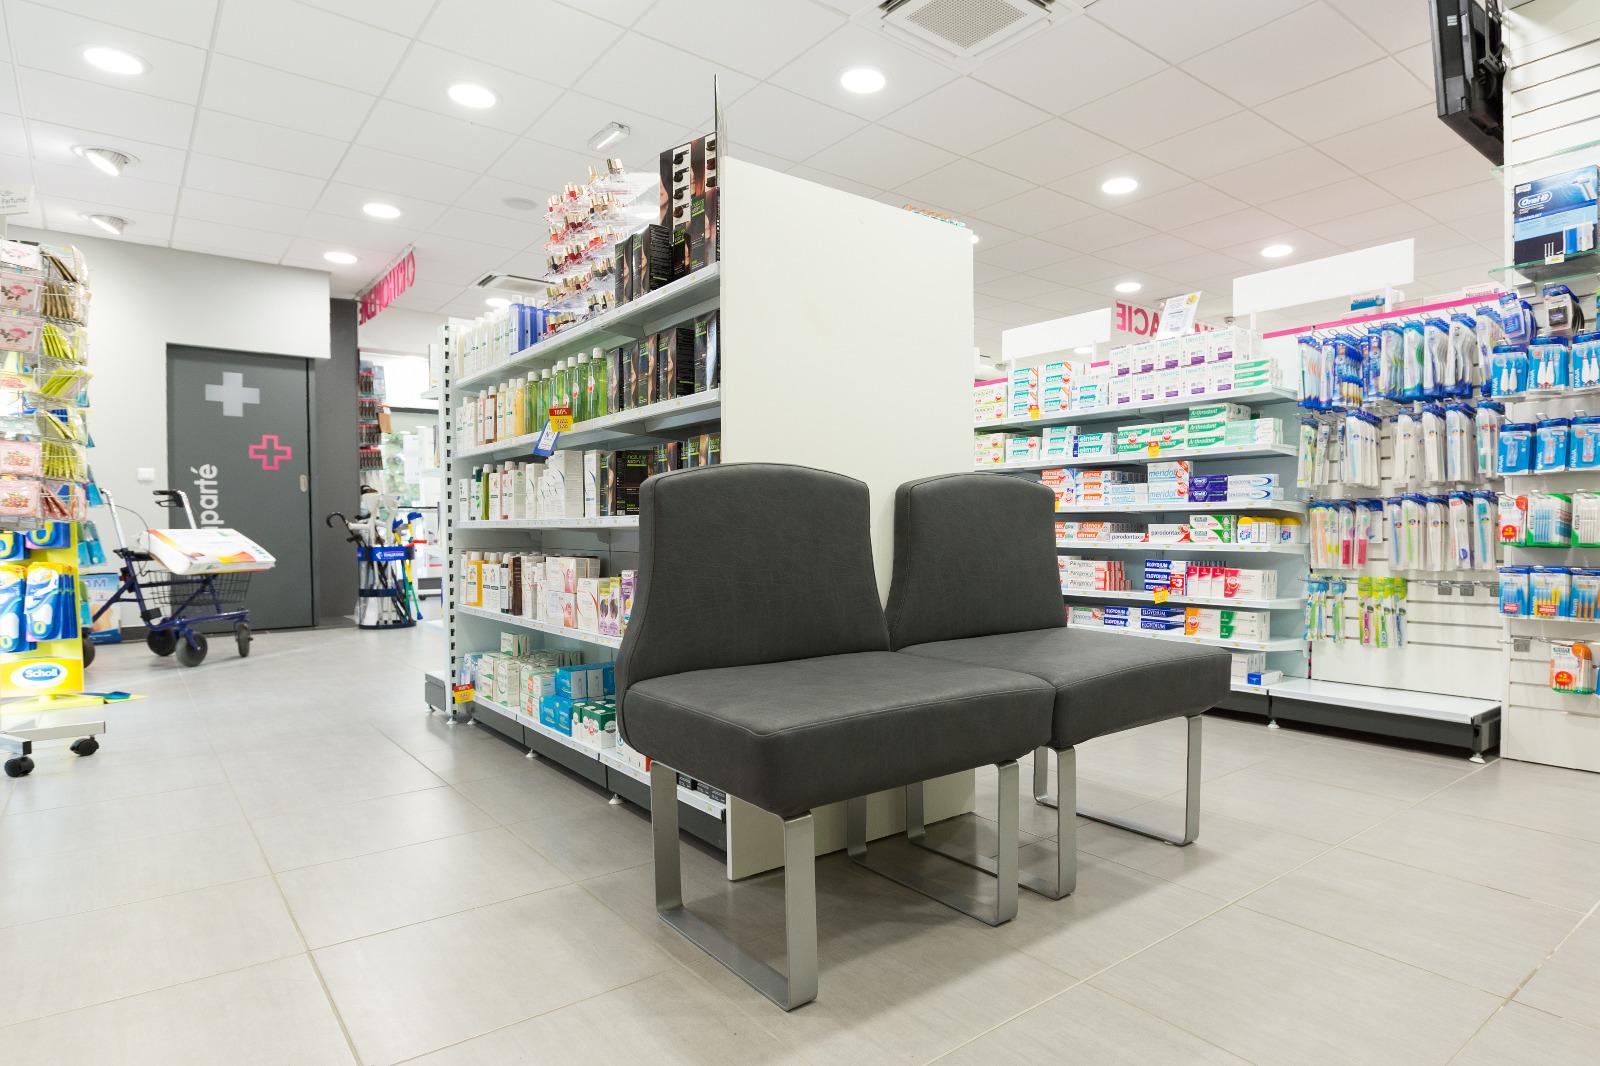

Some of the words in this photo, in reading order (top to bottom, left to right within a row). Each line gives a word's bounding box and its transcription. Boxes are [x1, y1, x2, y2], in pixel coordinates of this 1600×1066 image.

[1521, 192, 1550, 206] Oral-B
[1079, 434, 1103, 443] elmex
[1078, 445, 1103, 454] elmex
[1149, 470, 1176, 478] meridol
[190, 463, 224, 529] parté
[1149, 490, 1176, 498] meridol
[1111, 533, 1144, 541] parodontax
[24, 668, 58, 678] Scholl
